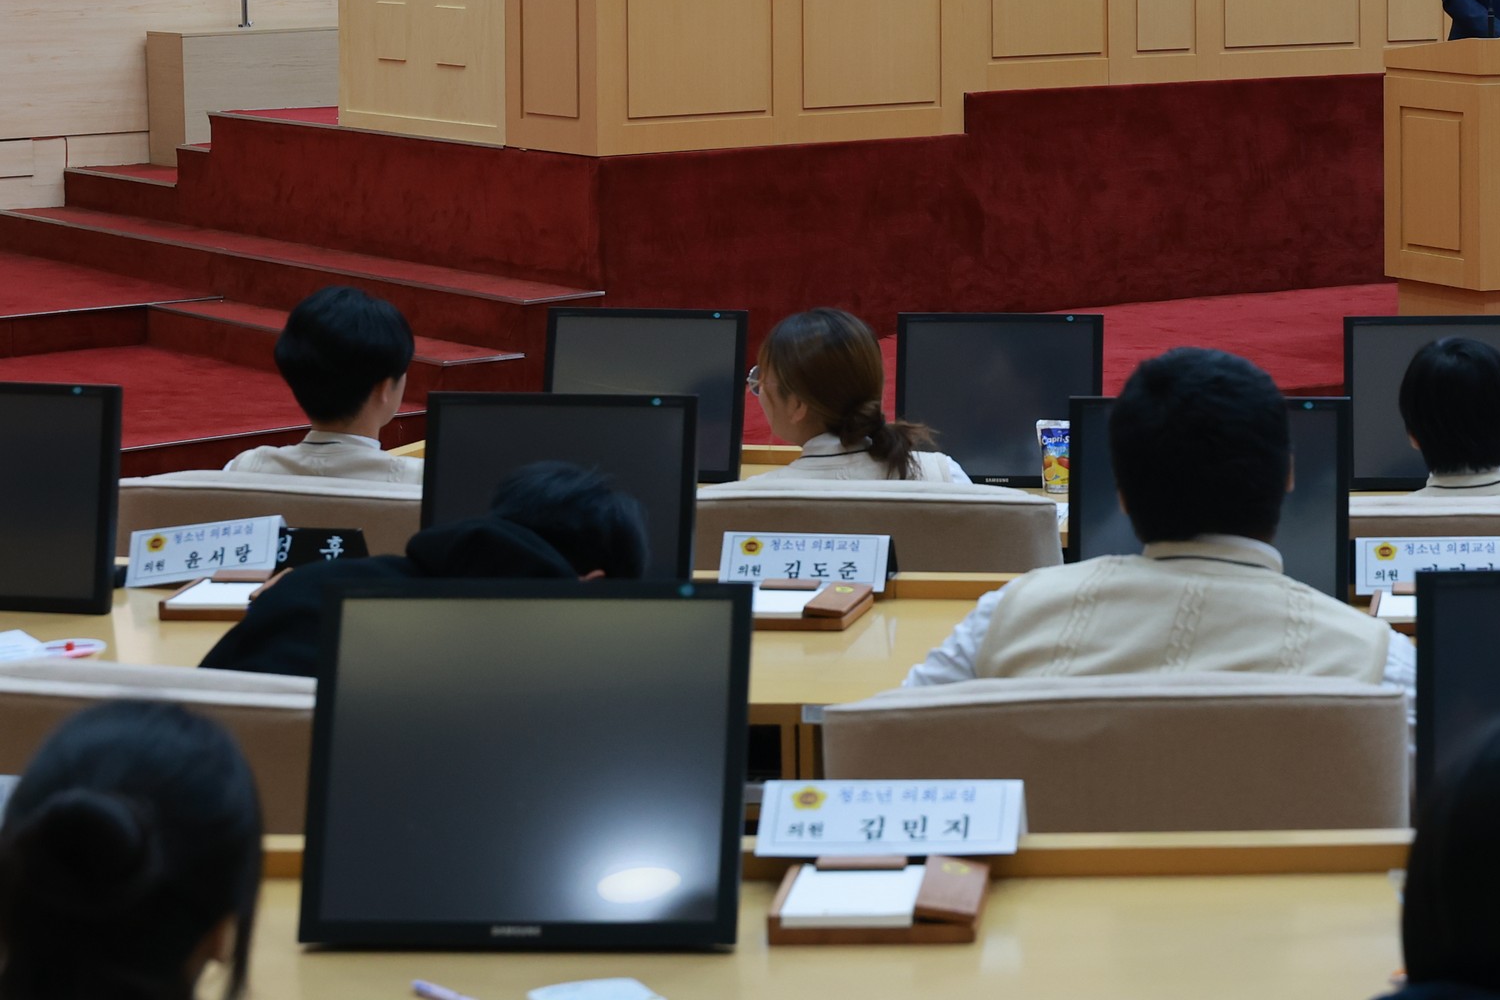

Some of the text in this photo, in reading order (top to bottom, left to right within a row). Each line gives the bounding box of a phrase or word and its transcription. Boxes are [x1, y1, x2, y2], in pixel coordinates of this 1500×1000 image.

[770, 538, 861, 552] 청소년 의회교실
[1404, 541, 1496, 556] 청소년 의회교실
[144, 559, 166, 572] 의원
[738, 560, 858, 580] 의원 김도준
[1374, 568, 1399, 582] 의원
[838, 786, 893, 803] 청소년
[859, 814, 971, 841] 김민지
